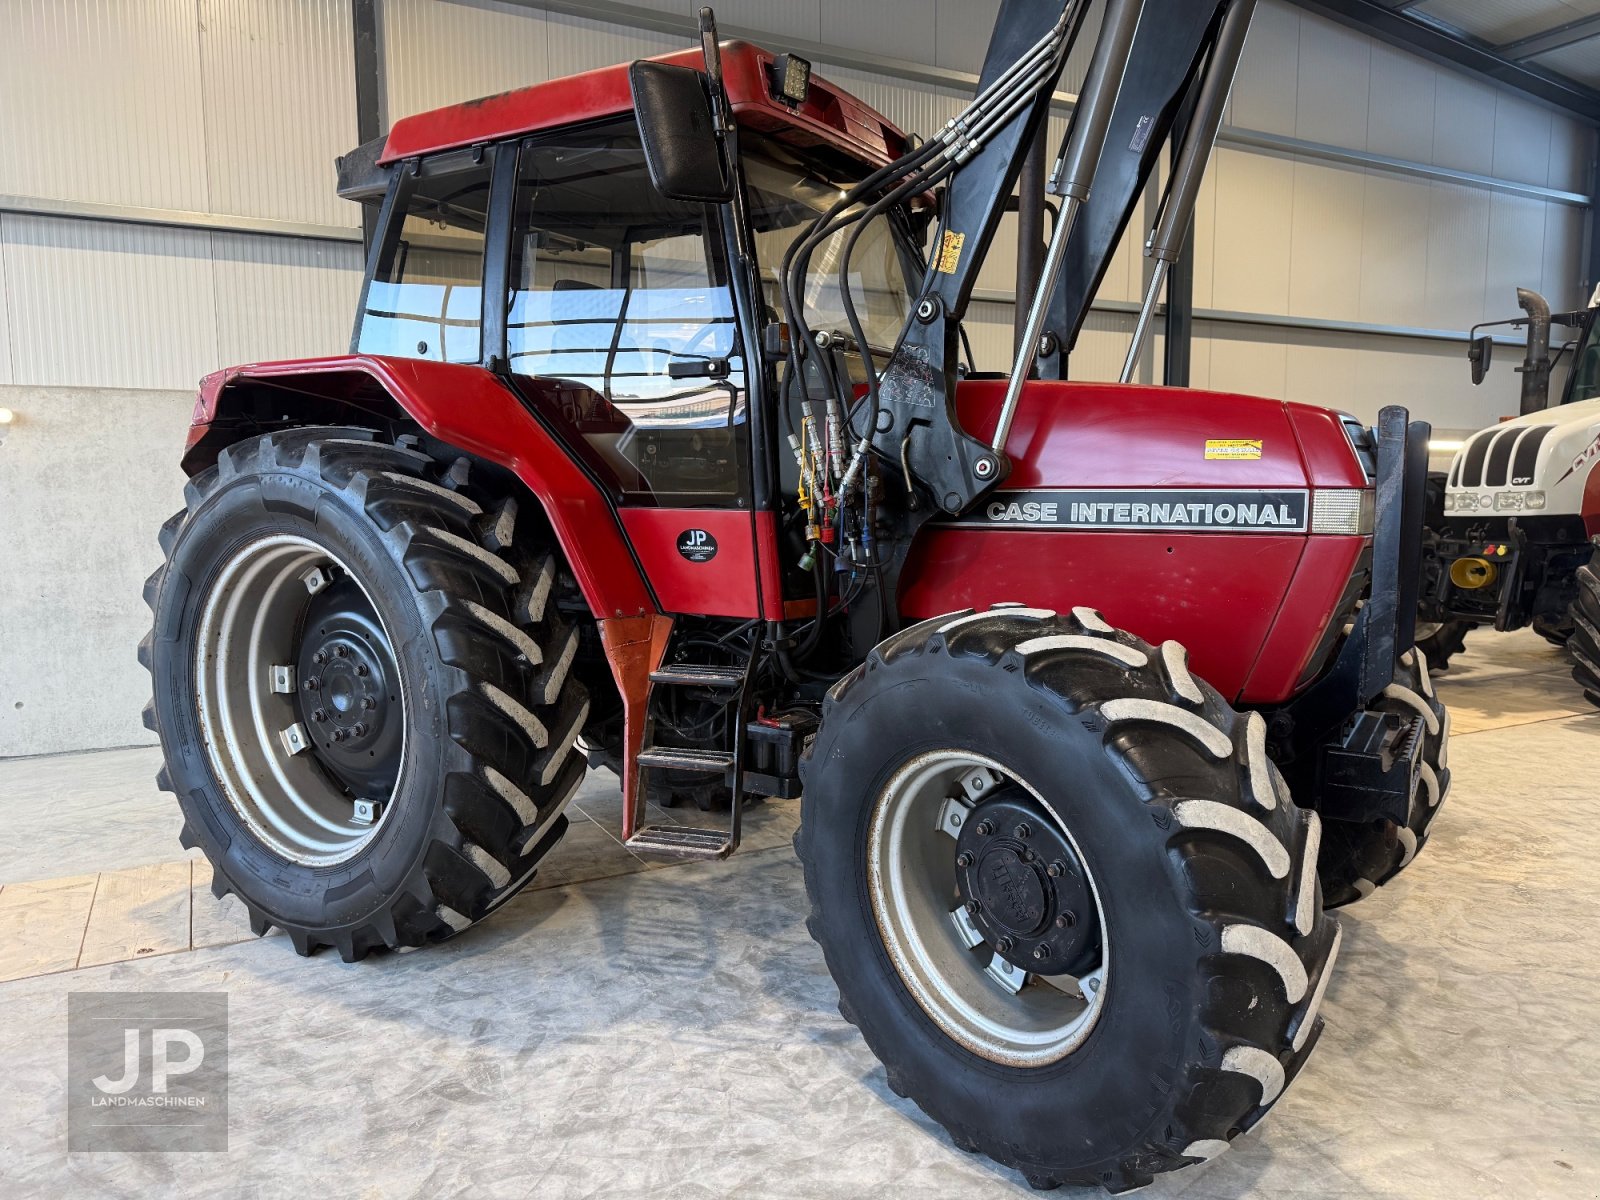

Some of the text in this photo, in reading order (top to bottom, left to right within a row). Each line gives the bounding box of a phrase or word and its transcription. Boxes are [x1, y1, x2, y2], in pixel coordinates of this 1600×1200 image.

[987, 502, 1297, 525] CASE INTERNATIONAL
[686, 530, 707, 546] JP
